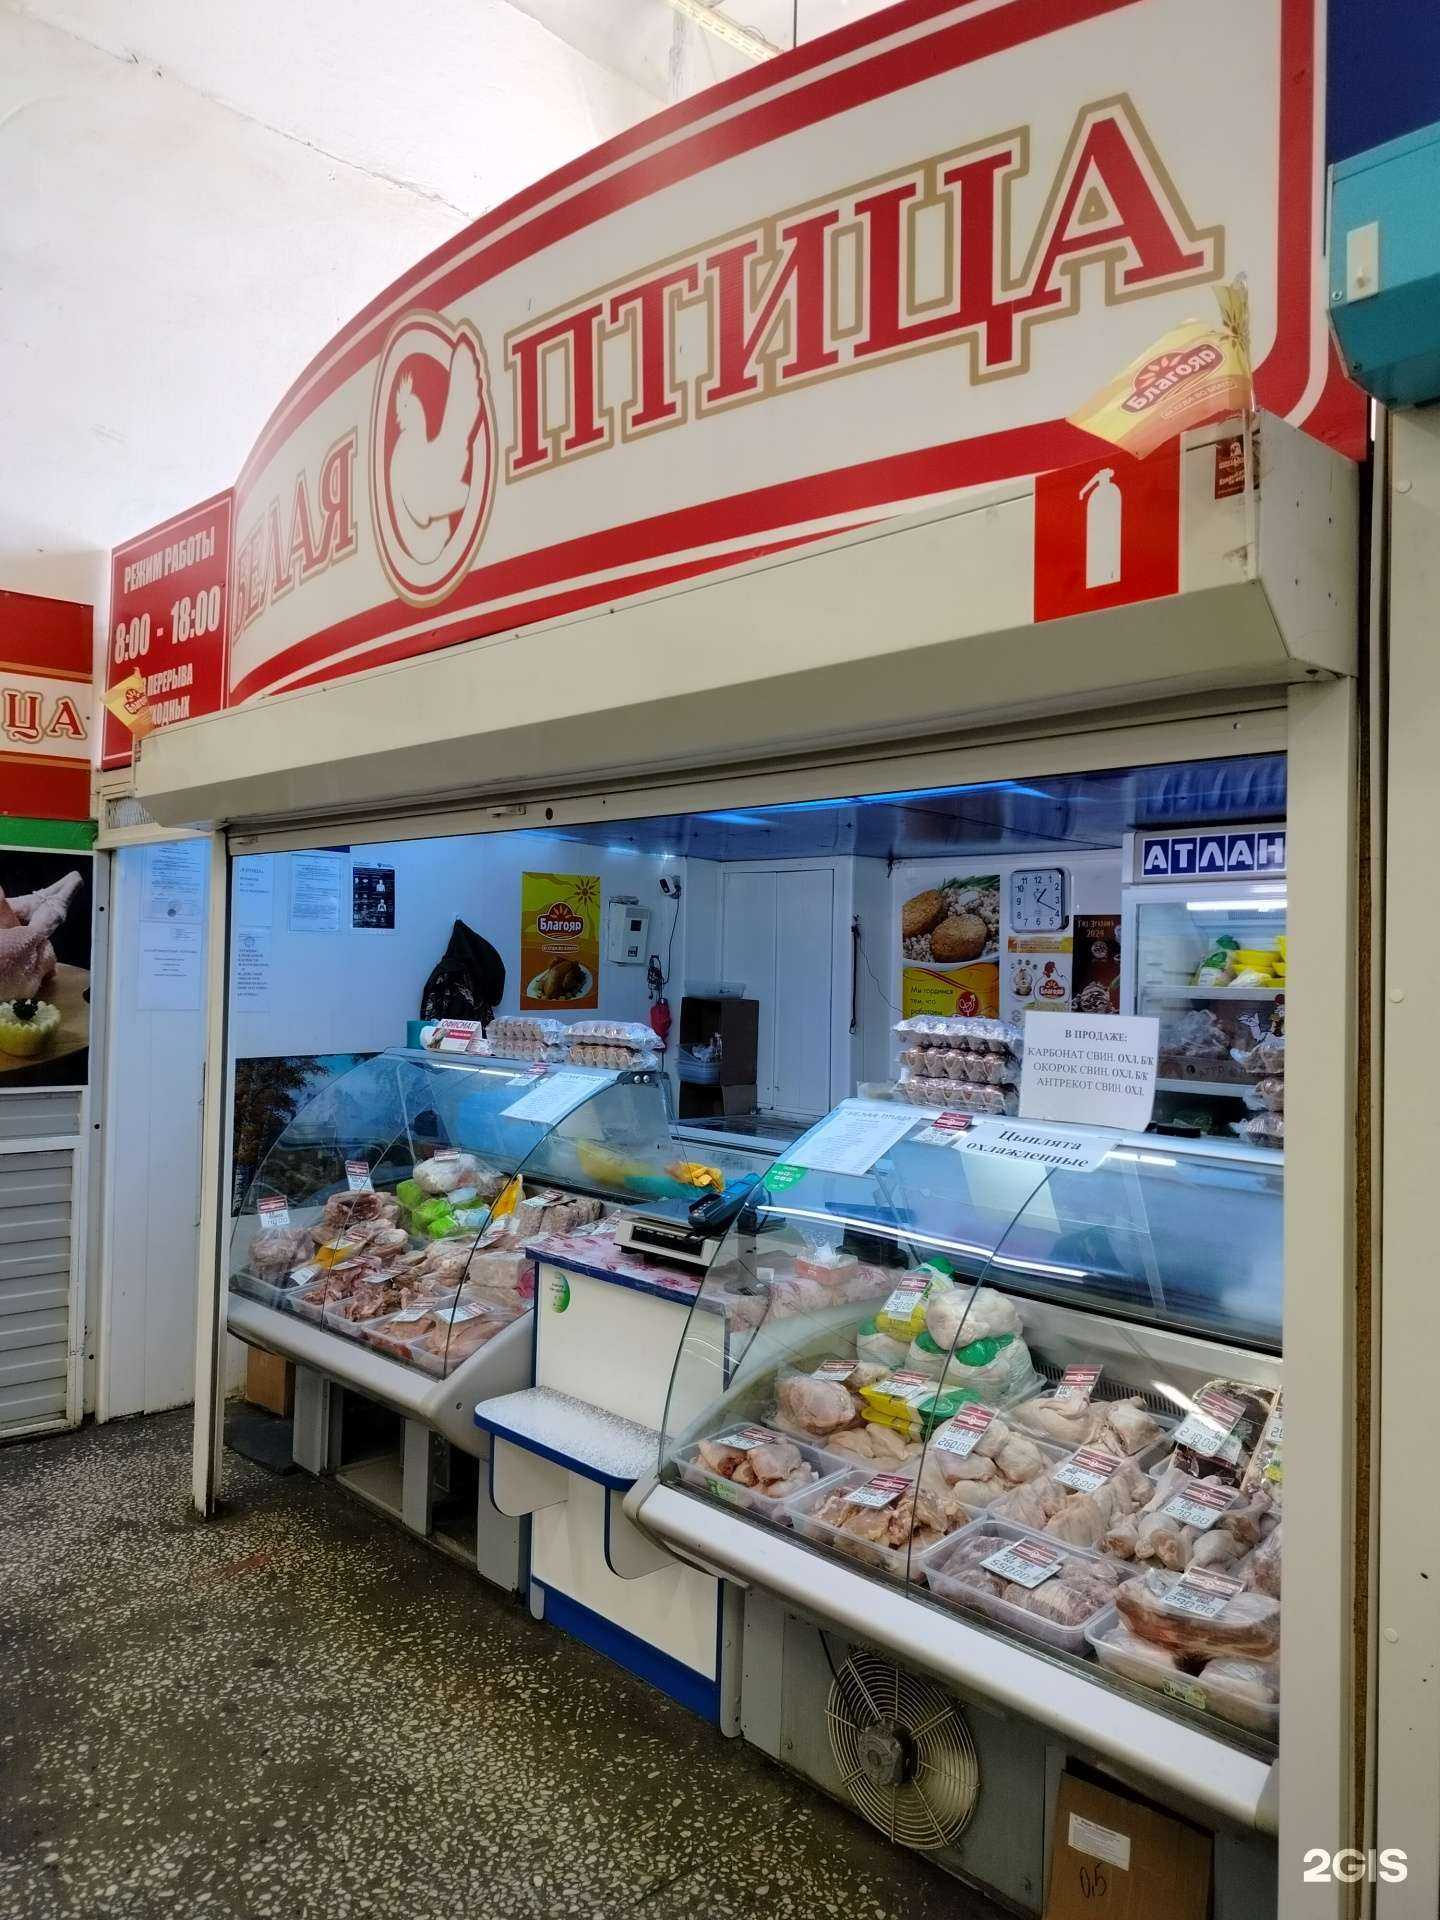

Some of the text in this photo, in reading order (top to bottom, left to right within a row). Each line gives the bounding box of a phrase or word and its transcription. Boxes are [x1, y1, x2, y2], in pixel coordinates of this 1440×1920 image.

[505, 93, 1224, 484] ПТИЦА
[1126, 347, 1218, 411] Благояр
[123, 525, 216, 594] РЕЖИМ РАБОТЫ
[114, 612, 151, 664] 8:00
[171, 585, 221, 644] 18:00
[147, 663, 193, 697] ПЕРЕРЫВА
[3, 688, 87, 744] ЦА
[1143, 837, 1284, 870] АТЛАН
[539, 917, 582, 932] Благояр
[1065, 1029, 1128, 1042] В ПРОДАЖЕ:
[1028, 1047, 1084, 1060] КАРБОНАТ
[1033, 1063, 1077, 1075] ОКОРОК
[1037, 1077, 1092, 1090] АНТРЕКОТ
[966, 1140, 1090, 1169] охлажденные
[999, 1128, 1083, 1151] Цыплята
